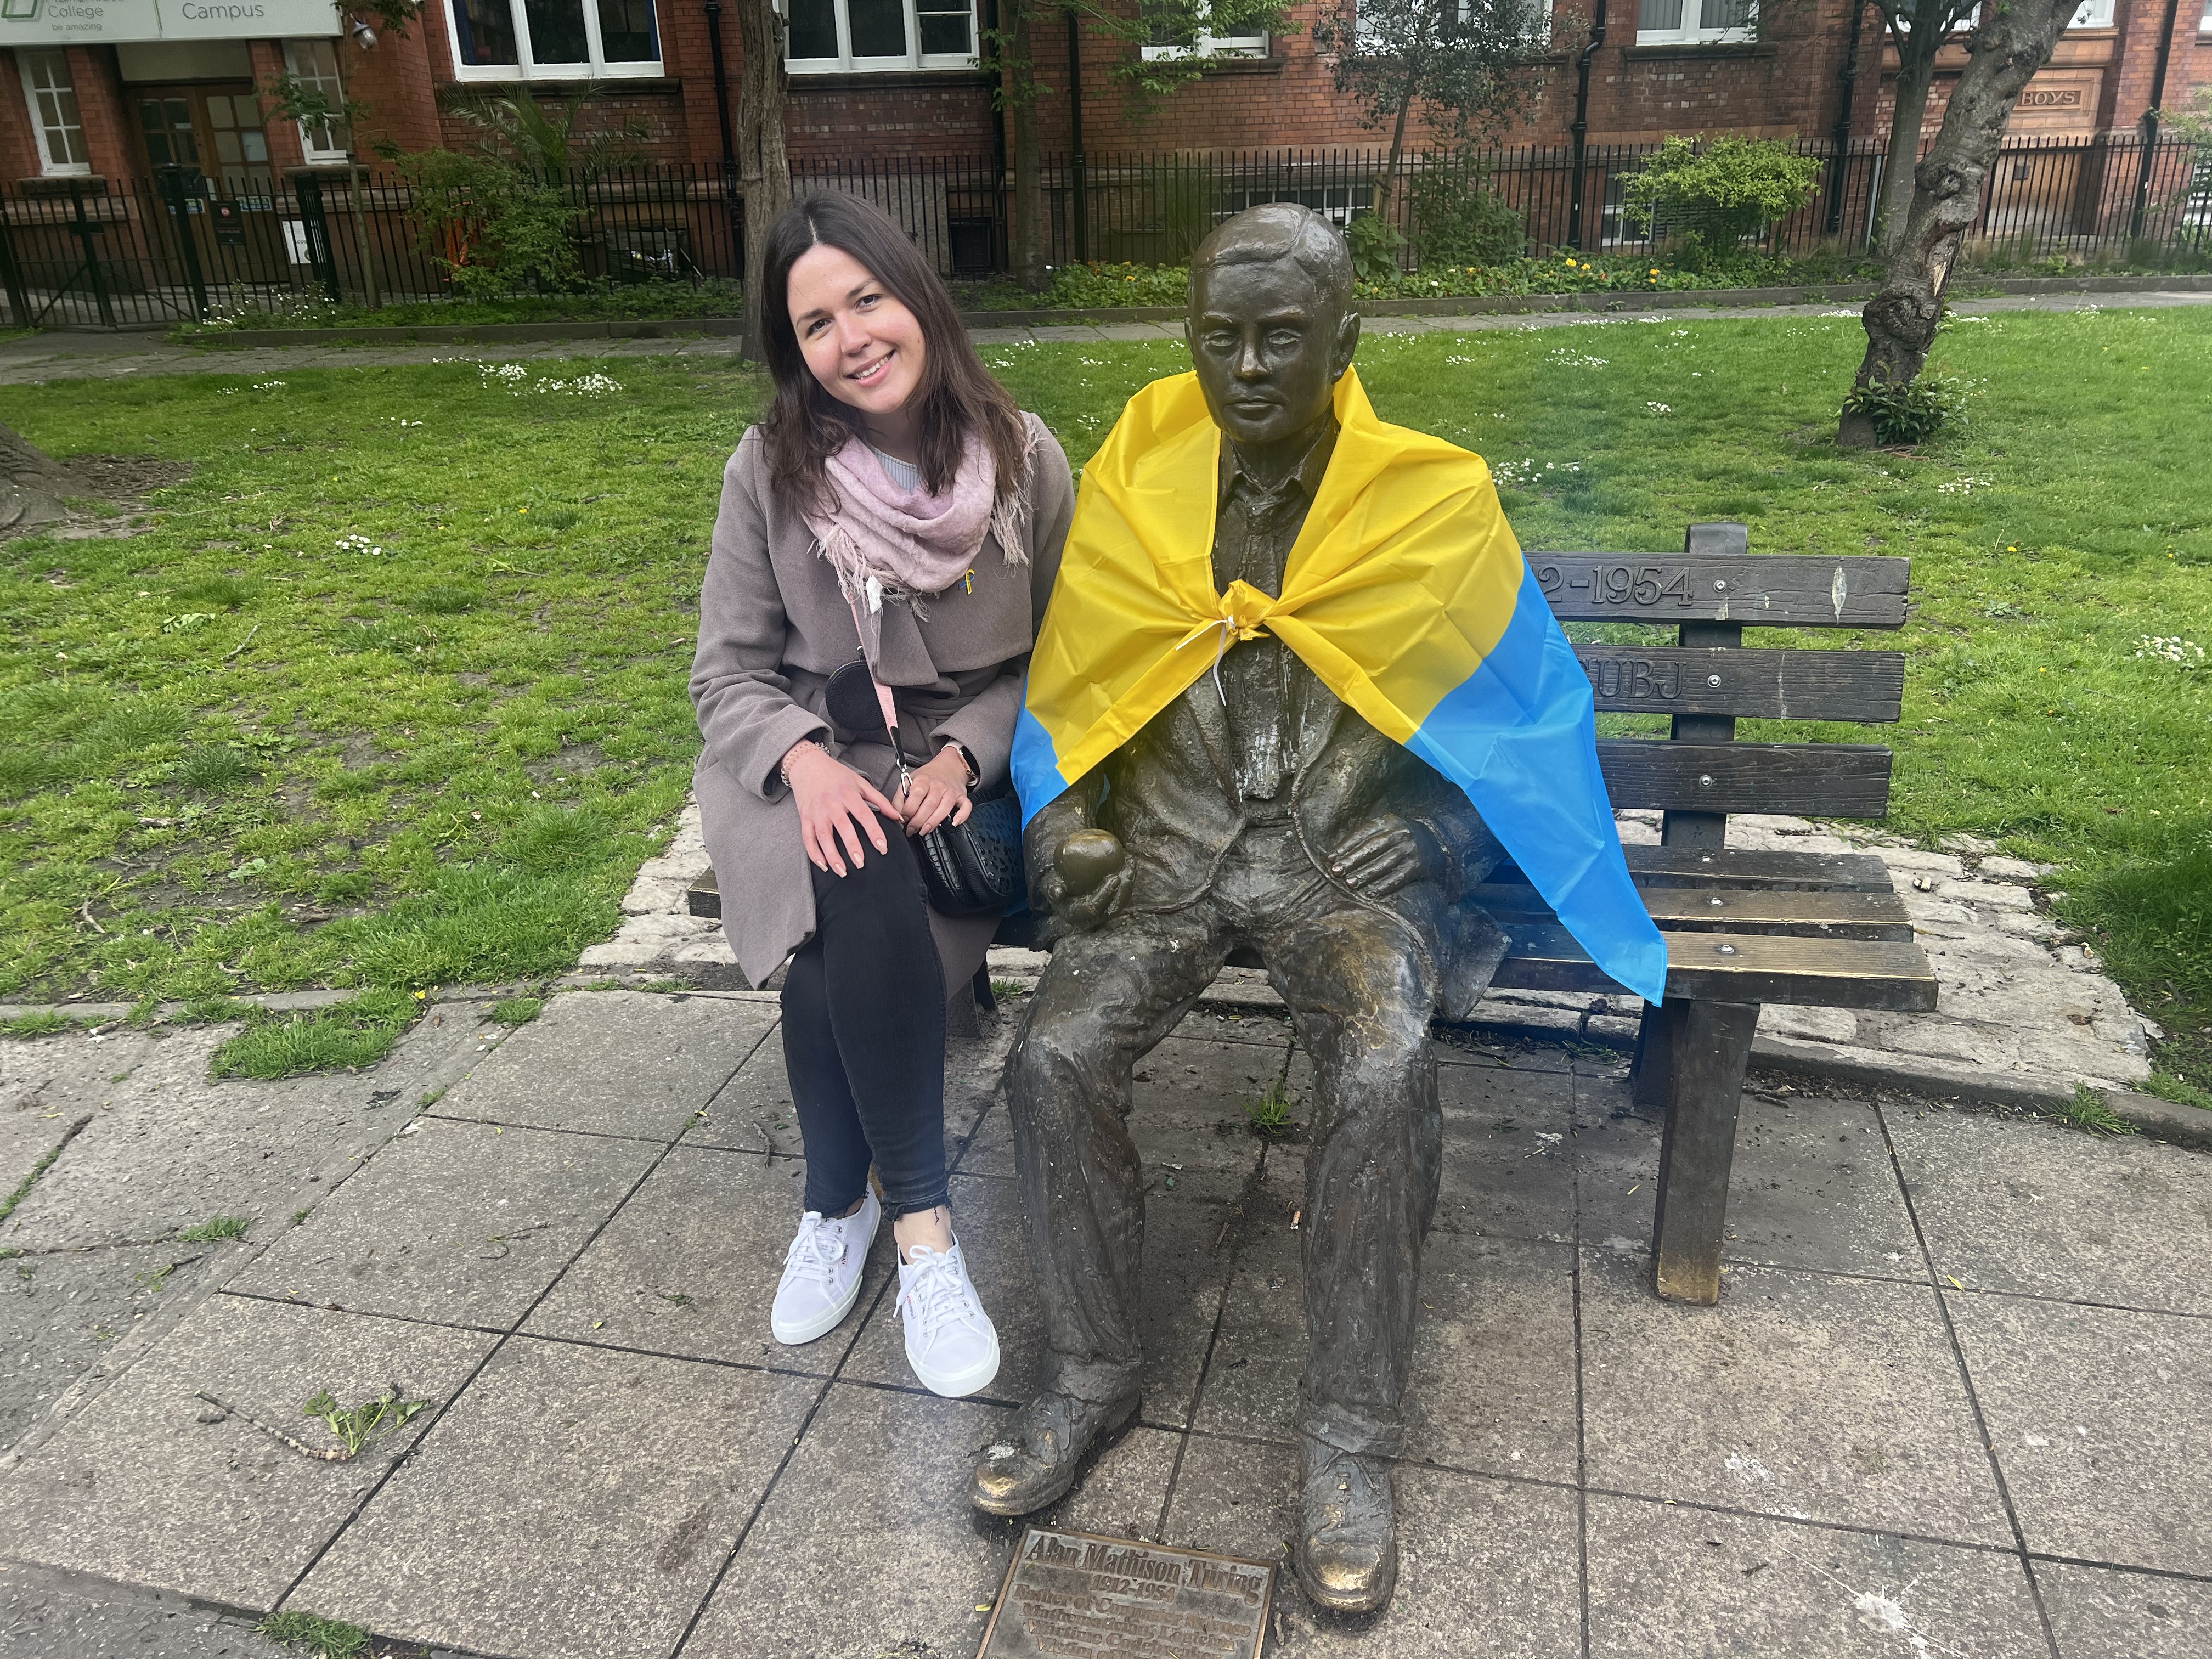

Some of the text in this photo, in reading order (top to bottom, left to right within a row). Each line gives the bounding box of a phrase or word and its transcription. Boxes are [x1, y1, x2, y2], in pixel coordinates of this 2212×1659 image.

[48, 5, 104, 19] College
[182, 3, 264, 21] Campus
[66, 23, 103, 31] amazing
[2021, 91, 2075, 105] BOYS
[1530, 565, 1694, 606] 2-1954
[1025, 1535, 1263, 1606] Alan Mathison Turing
[1090, 1575, 1176, 1602] 1912-1954
[1012, 1583, 1251, 1638] Father of Computer Science
[1029, 1619, 1103, 1644] Wartime
